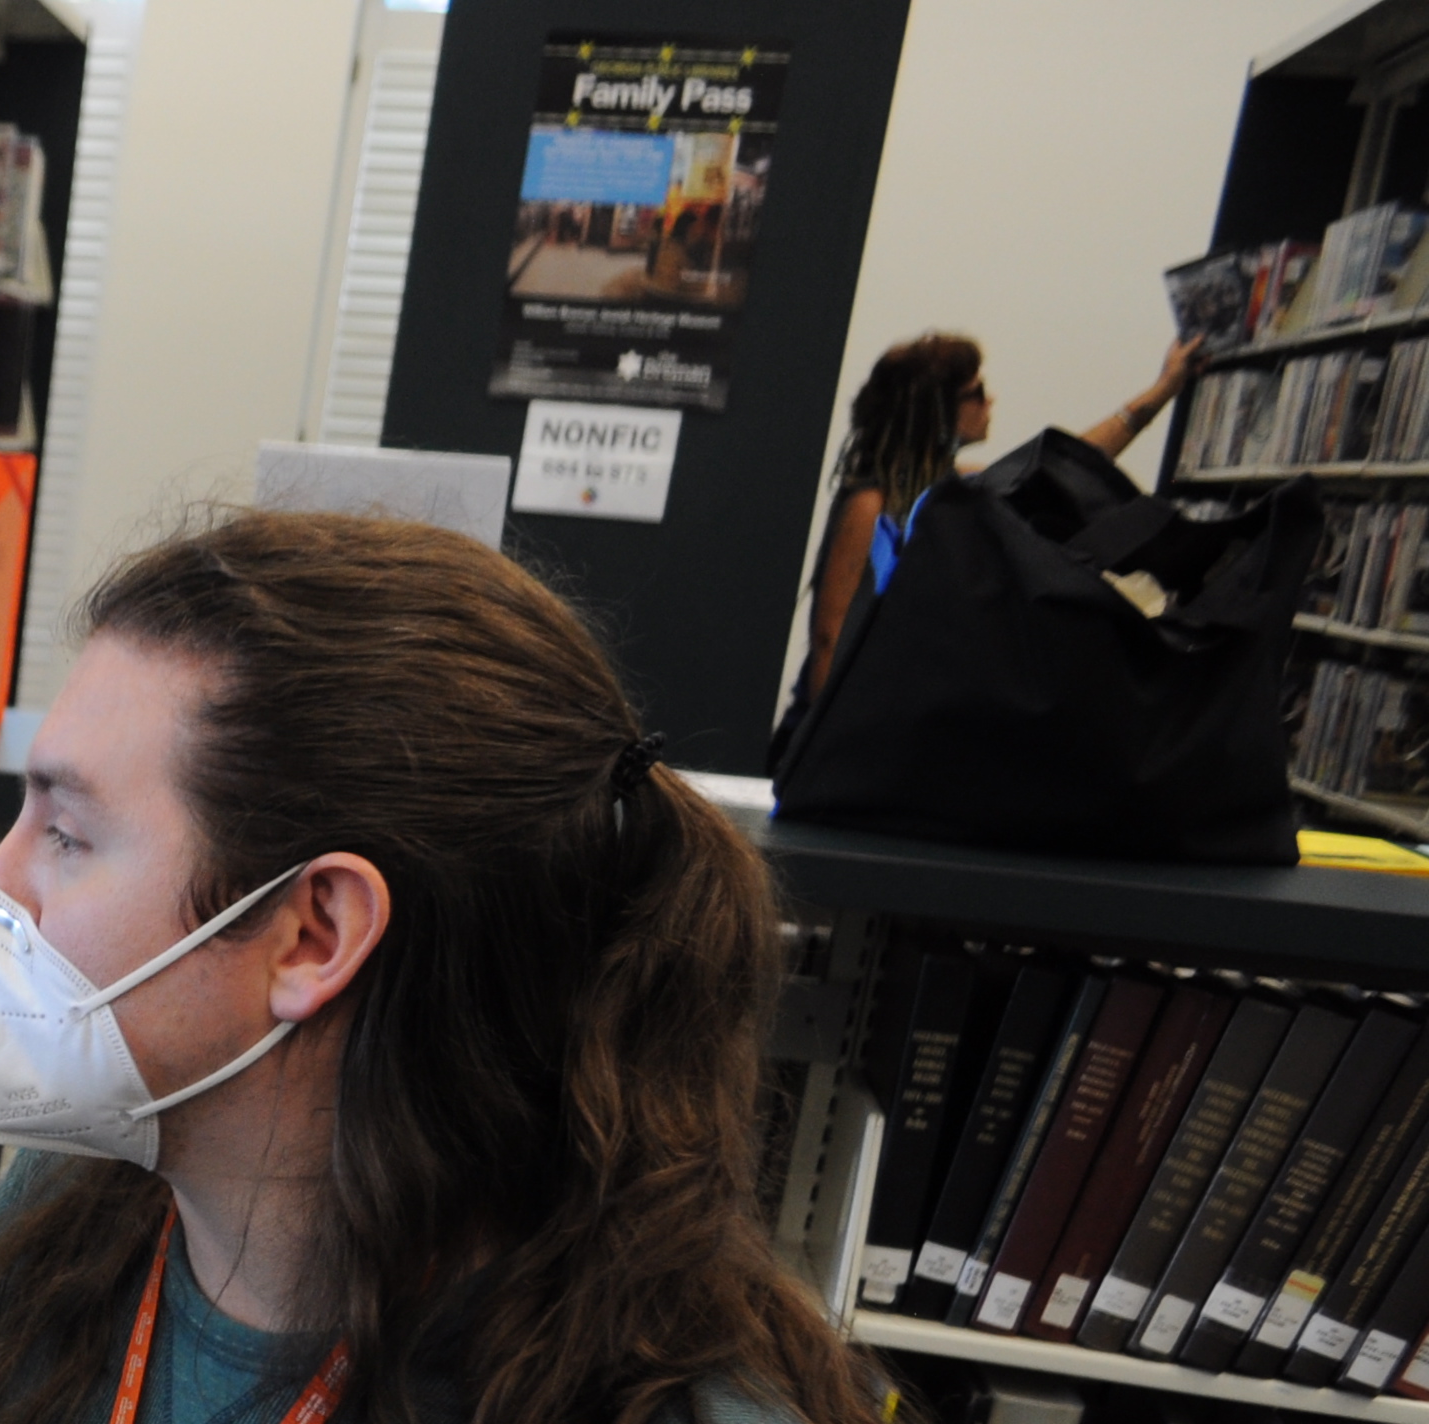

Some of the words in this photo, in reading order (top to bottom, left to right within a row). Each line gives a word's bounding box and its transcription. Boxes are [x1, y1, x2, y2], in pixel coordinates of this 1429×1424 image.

[572, 72, 676, 119] Family
[681, 77, 753, 113] Pass
[541, 419, 662, 451] NONFIC
